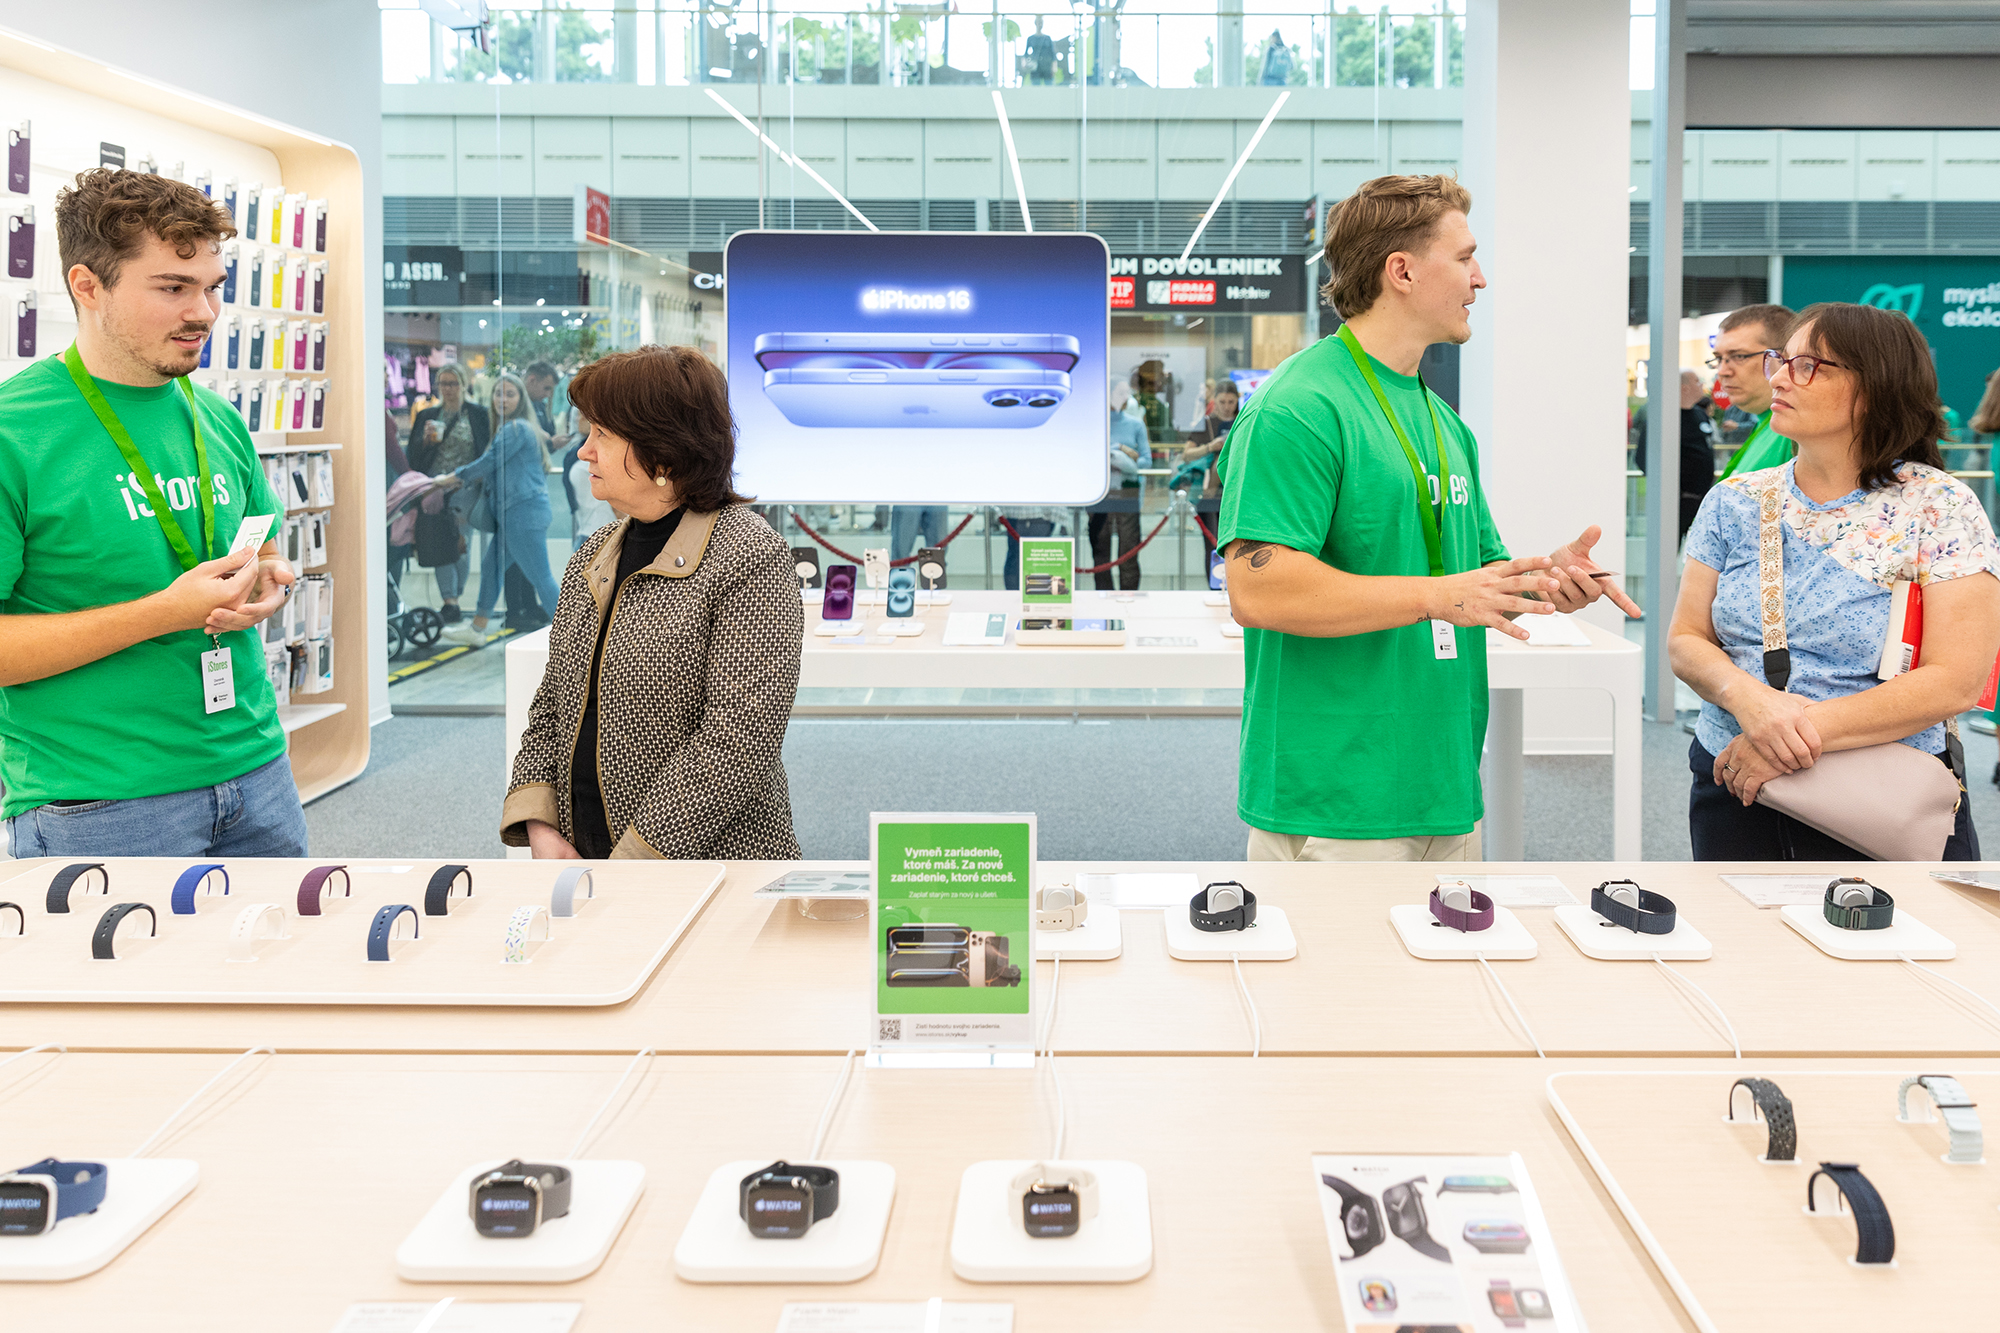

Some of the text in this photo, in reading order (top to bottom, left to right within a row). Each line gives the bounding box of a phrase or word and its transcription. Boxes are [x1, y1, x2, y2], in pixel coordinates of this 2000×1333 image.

[400, 262, 449, 281] ASSN.
[1142, 257, 1283, 275] DOVOLENIEK
[1171, 282, 1215, 292] KOALA
[879, 289, 970, 310] iPhone 16
[207, 660, 229, 673] iStores
[904, 847, 1003, 859] Vymeň zariadenie,
[903, 859, 1004, 870] ktoré máš. Za nové
[890, 872, 1017, 884] zariadenie, ktoré chceš.
[929, 891, 950, 899] starým
[959, 891, 974, 899] nový
[5, 1199, 41, 1210] WATCH
[493, 1200, 529, 1211] WATCH
[766, 1200, 801, 1211] WATCH
[1040, 1203, 1071, 1214] WATCH
